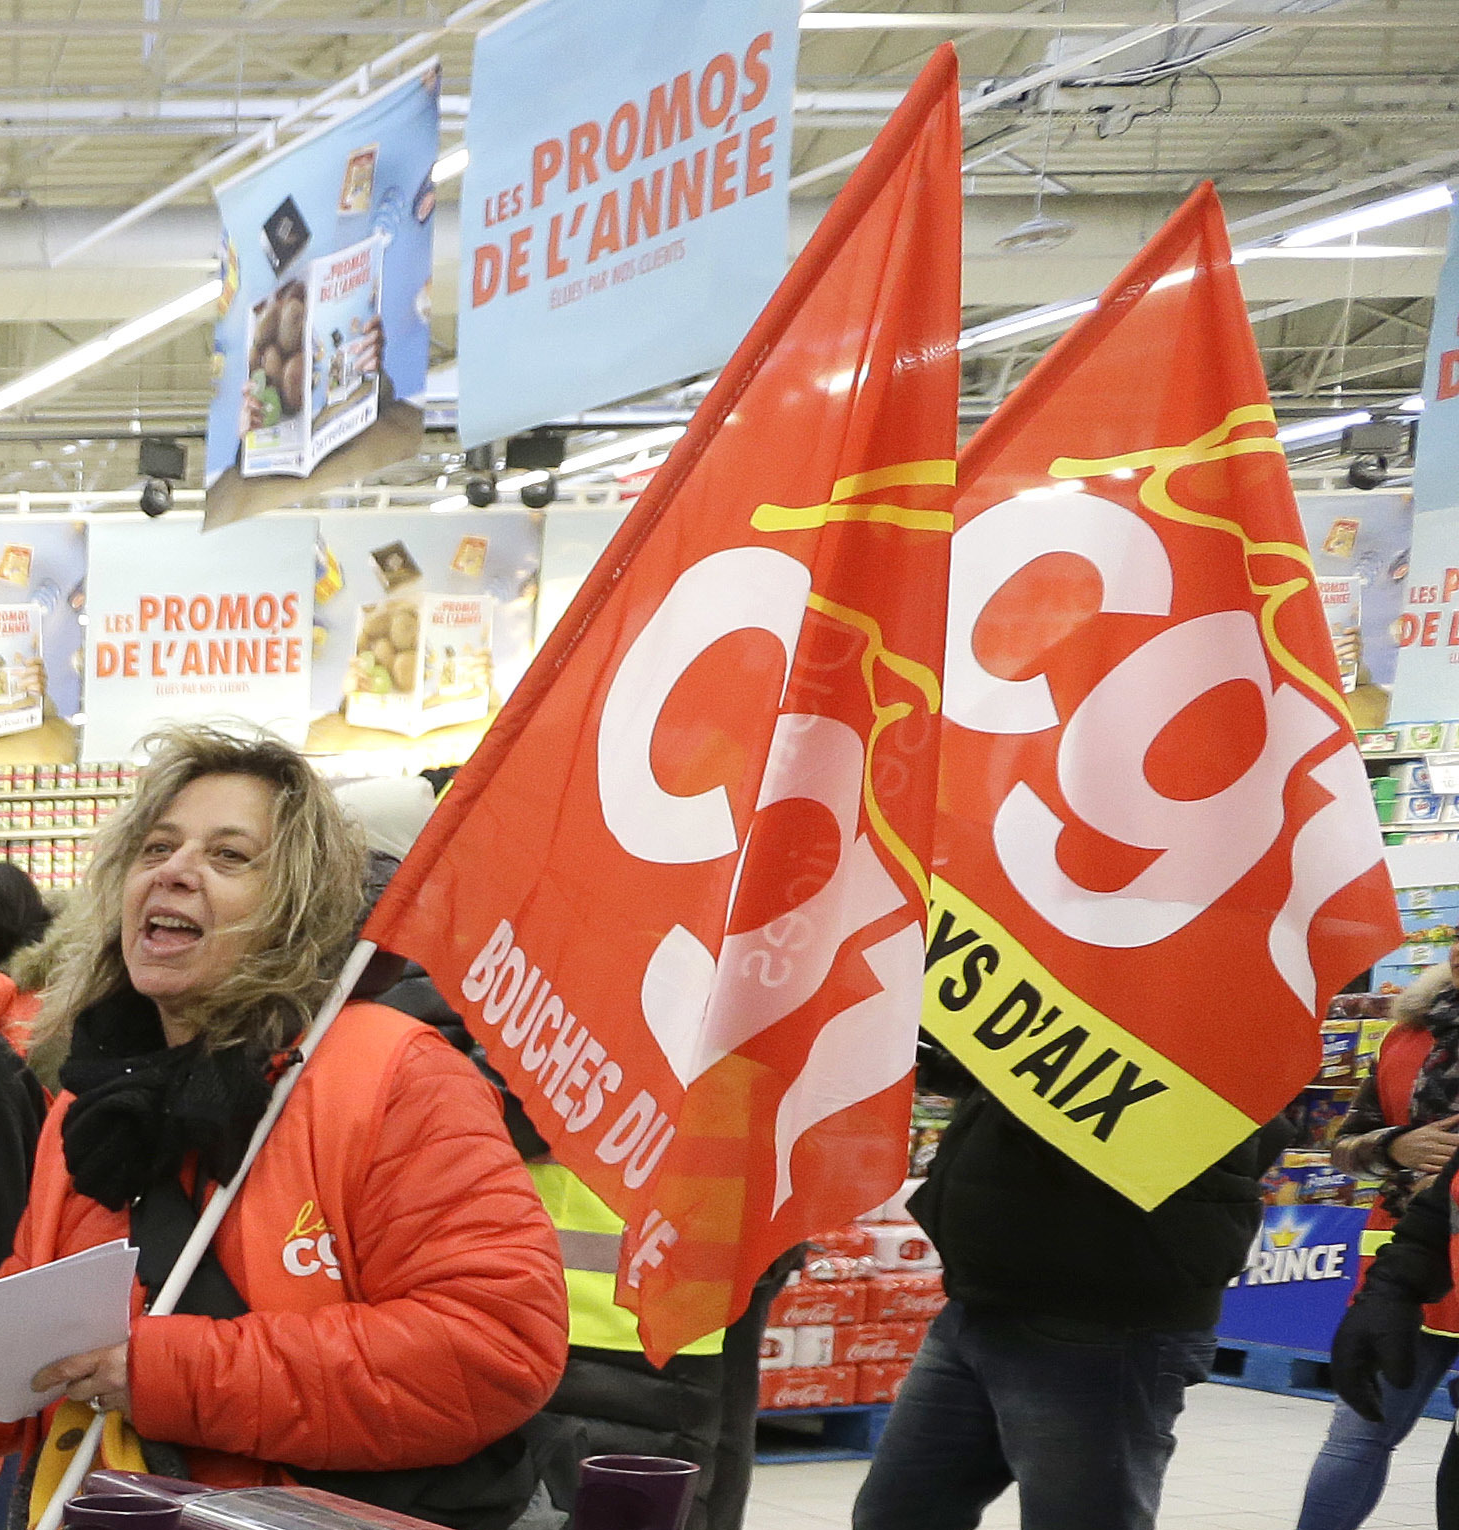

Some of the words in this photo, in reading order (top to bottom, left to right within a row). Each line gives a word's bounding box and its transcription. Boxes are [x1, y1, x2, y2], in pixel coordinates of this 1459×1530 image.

[484, 183, 525, 227] LES
[530, 31, 774, 209] PROMOS
[472, 224, 534, 309] DE
[105, 614, 134, 633] LES
[138, 591, 300, 633] PROMOS
[1409, 585, 1438, 604] LES
[1399, 611, 1442, 649] DE
[96, 640, 141, 678] DE
[923, 898, 1002, 1013] YS
[973, 984, 1169, 1144] D'AIX
[461, 918, 625, 1134] BOUCHES
[594, 1088, 678, 1190] DU
[281, 1236, 342, 1281] cg
